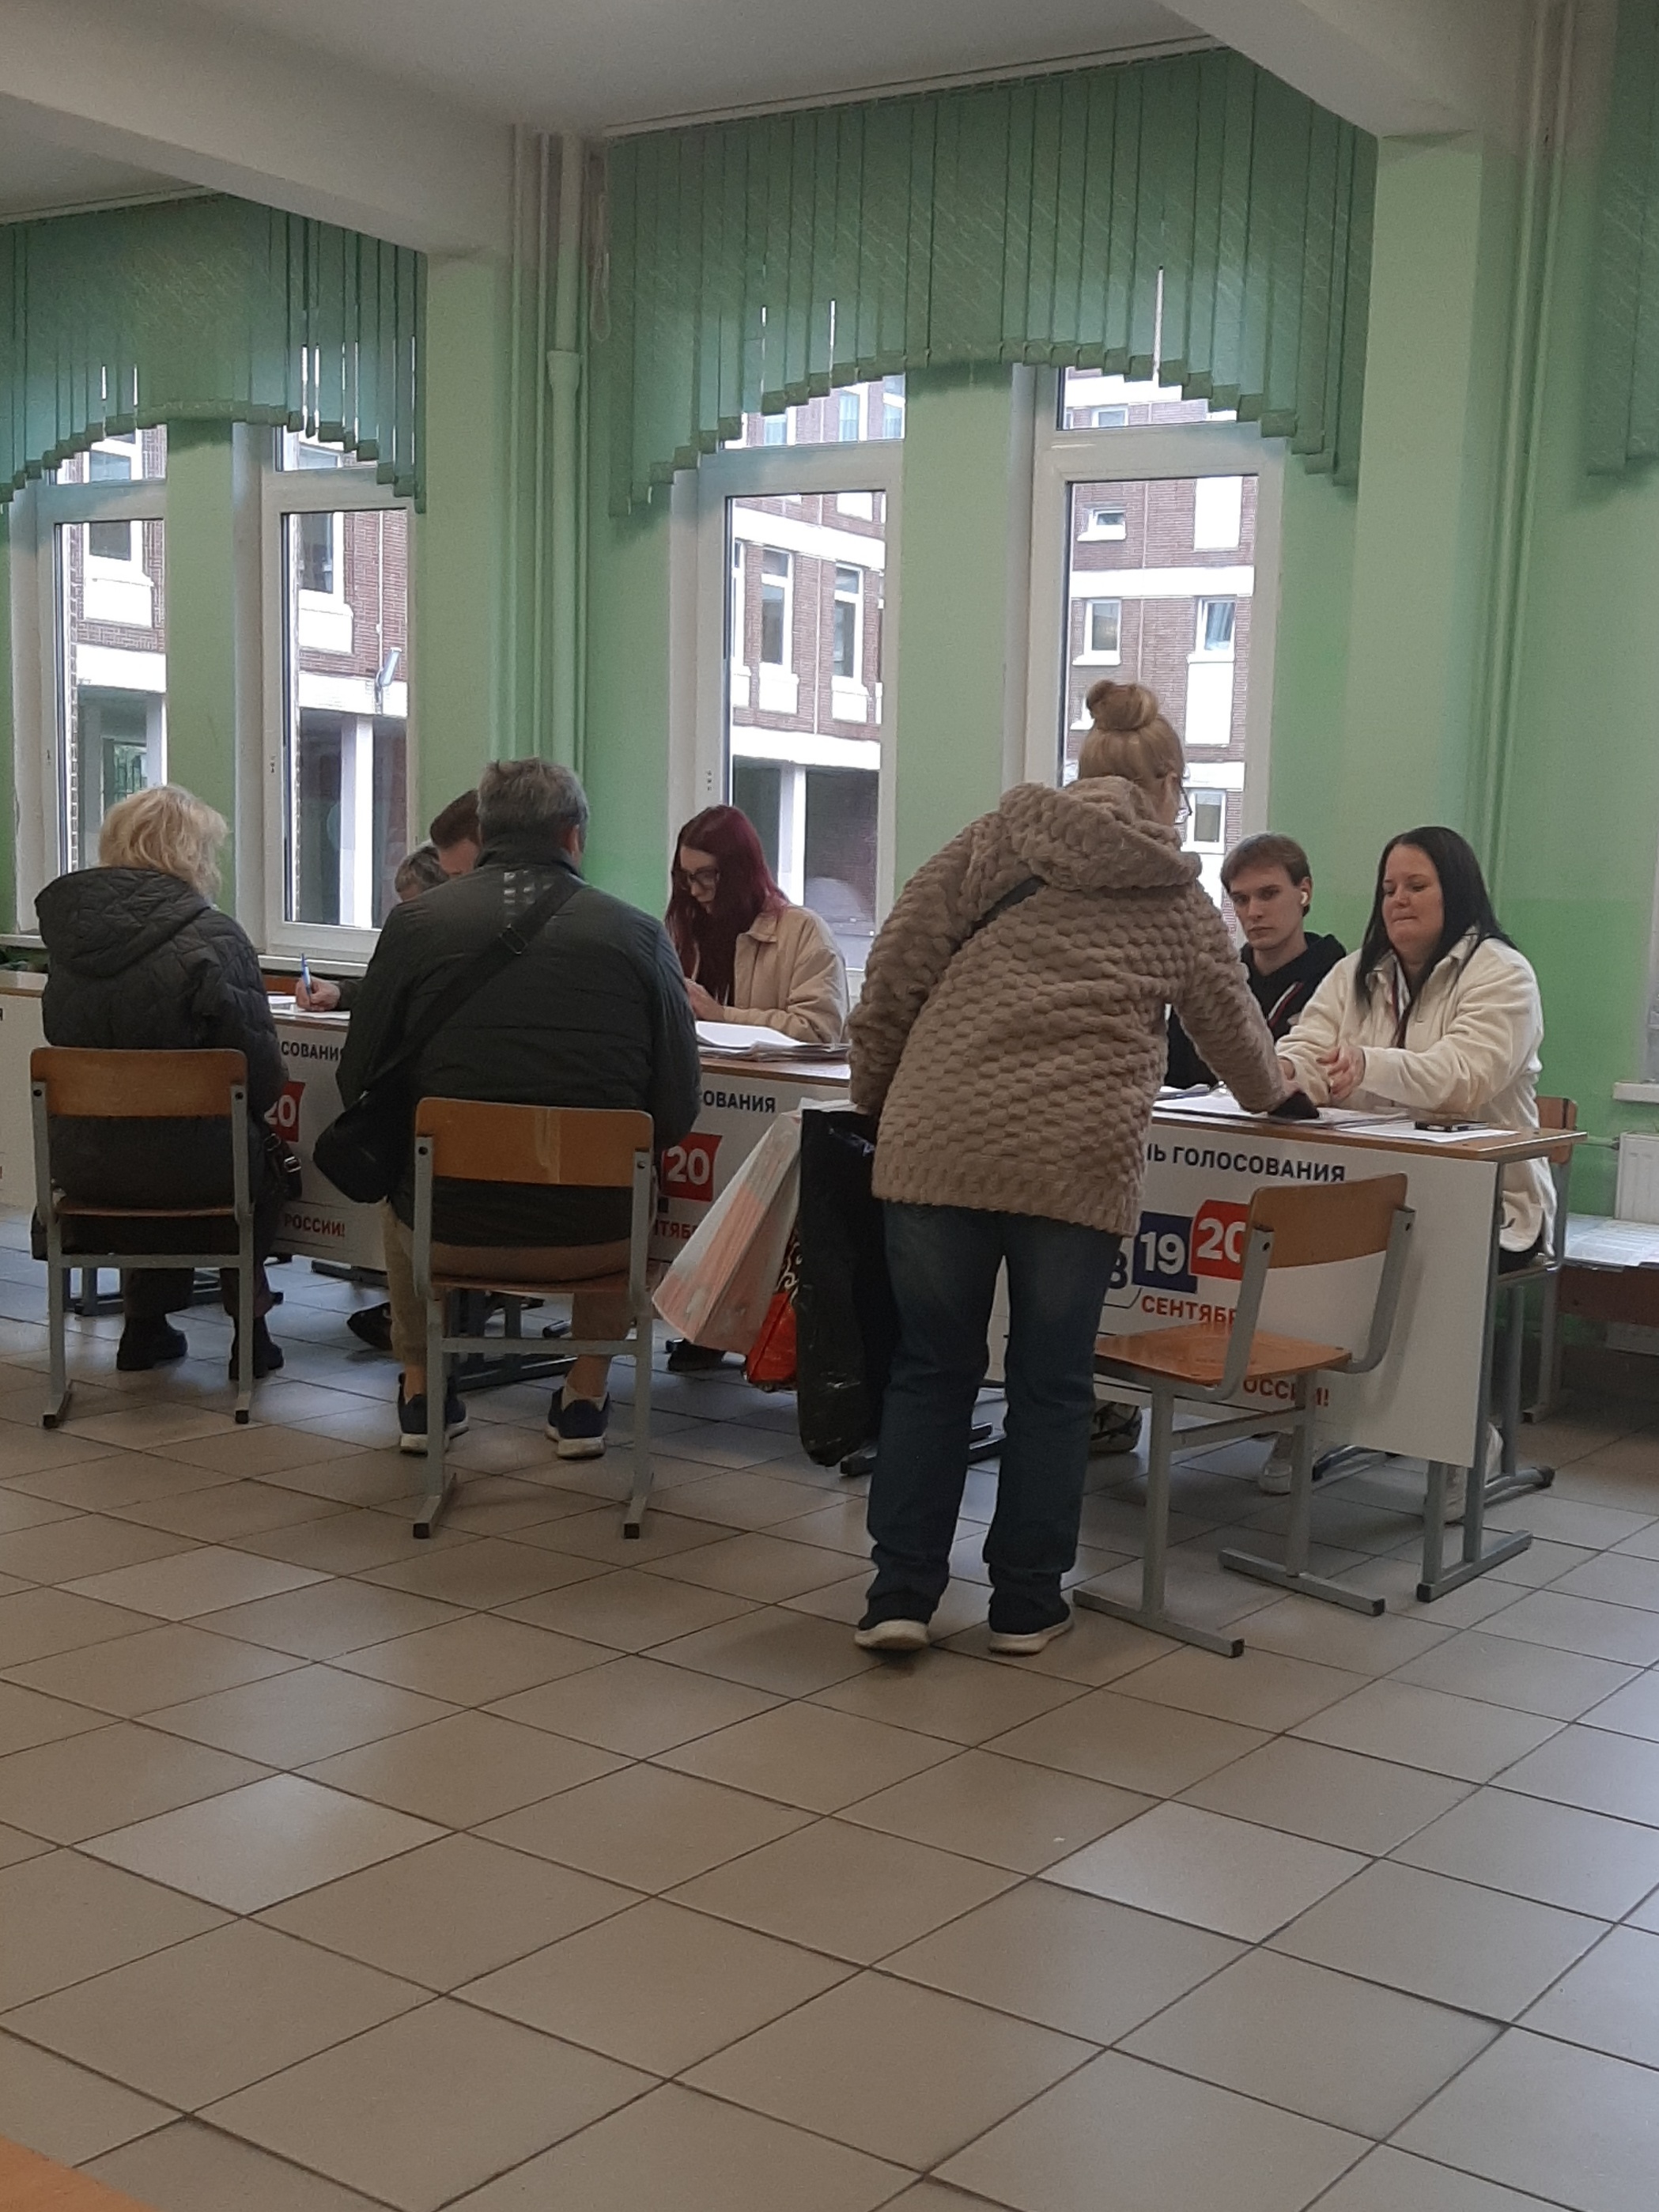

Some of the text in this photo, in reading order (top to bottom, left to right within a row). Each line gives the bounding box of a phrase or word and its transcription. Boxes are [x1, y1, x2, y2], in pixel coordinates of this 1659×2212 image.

[281, 1040, 342, 1061] СОВАНИ
[703, 1090, 777, 1114] ОВАНИЯ
[667, 1145, 711, 1186] 20
[1173, 1146, 1346, 1183] ГОЛОСОВАНИЯ
[285, 1212, 346, 1238] РОССИИ!
[1108, 1250, 1128, 1290] 8
[1140, 1231, 1186, 1276] 19
[1141, 1295, 1237, 1326] СЕНТЯБ
